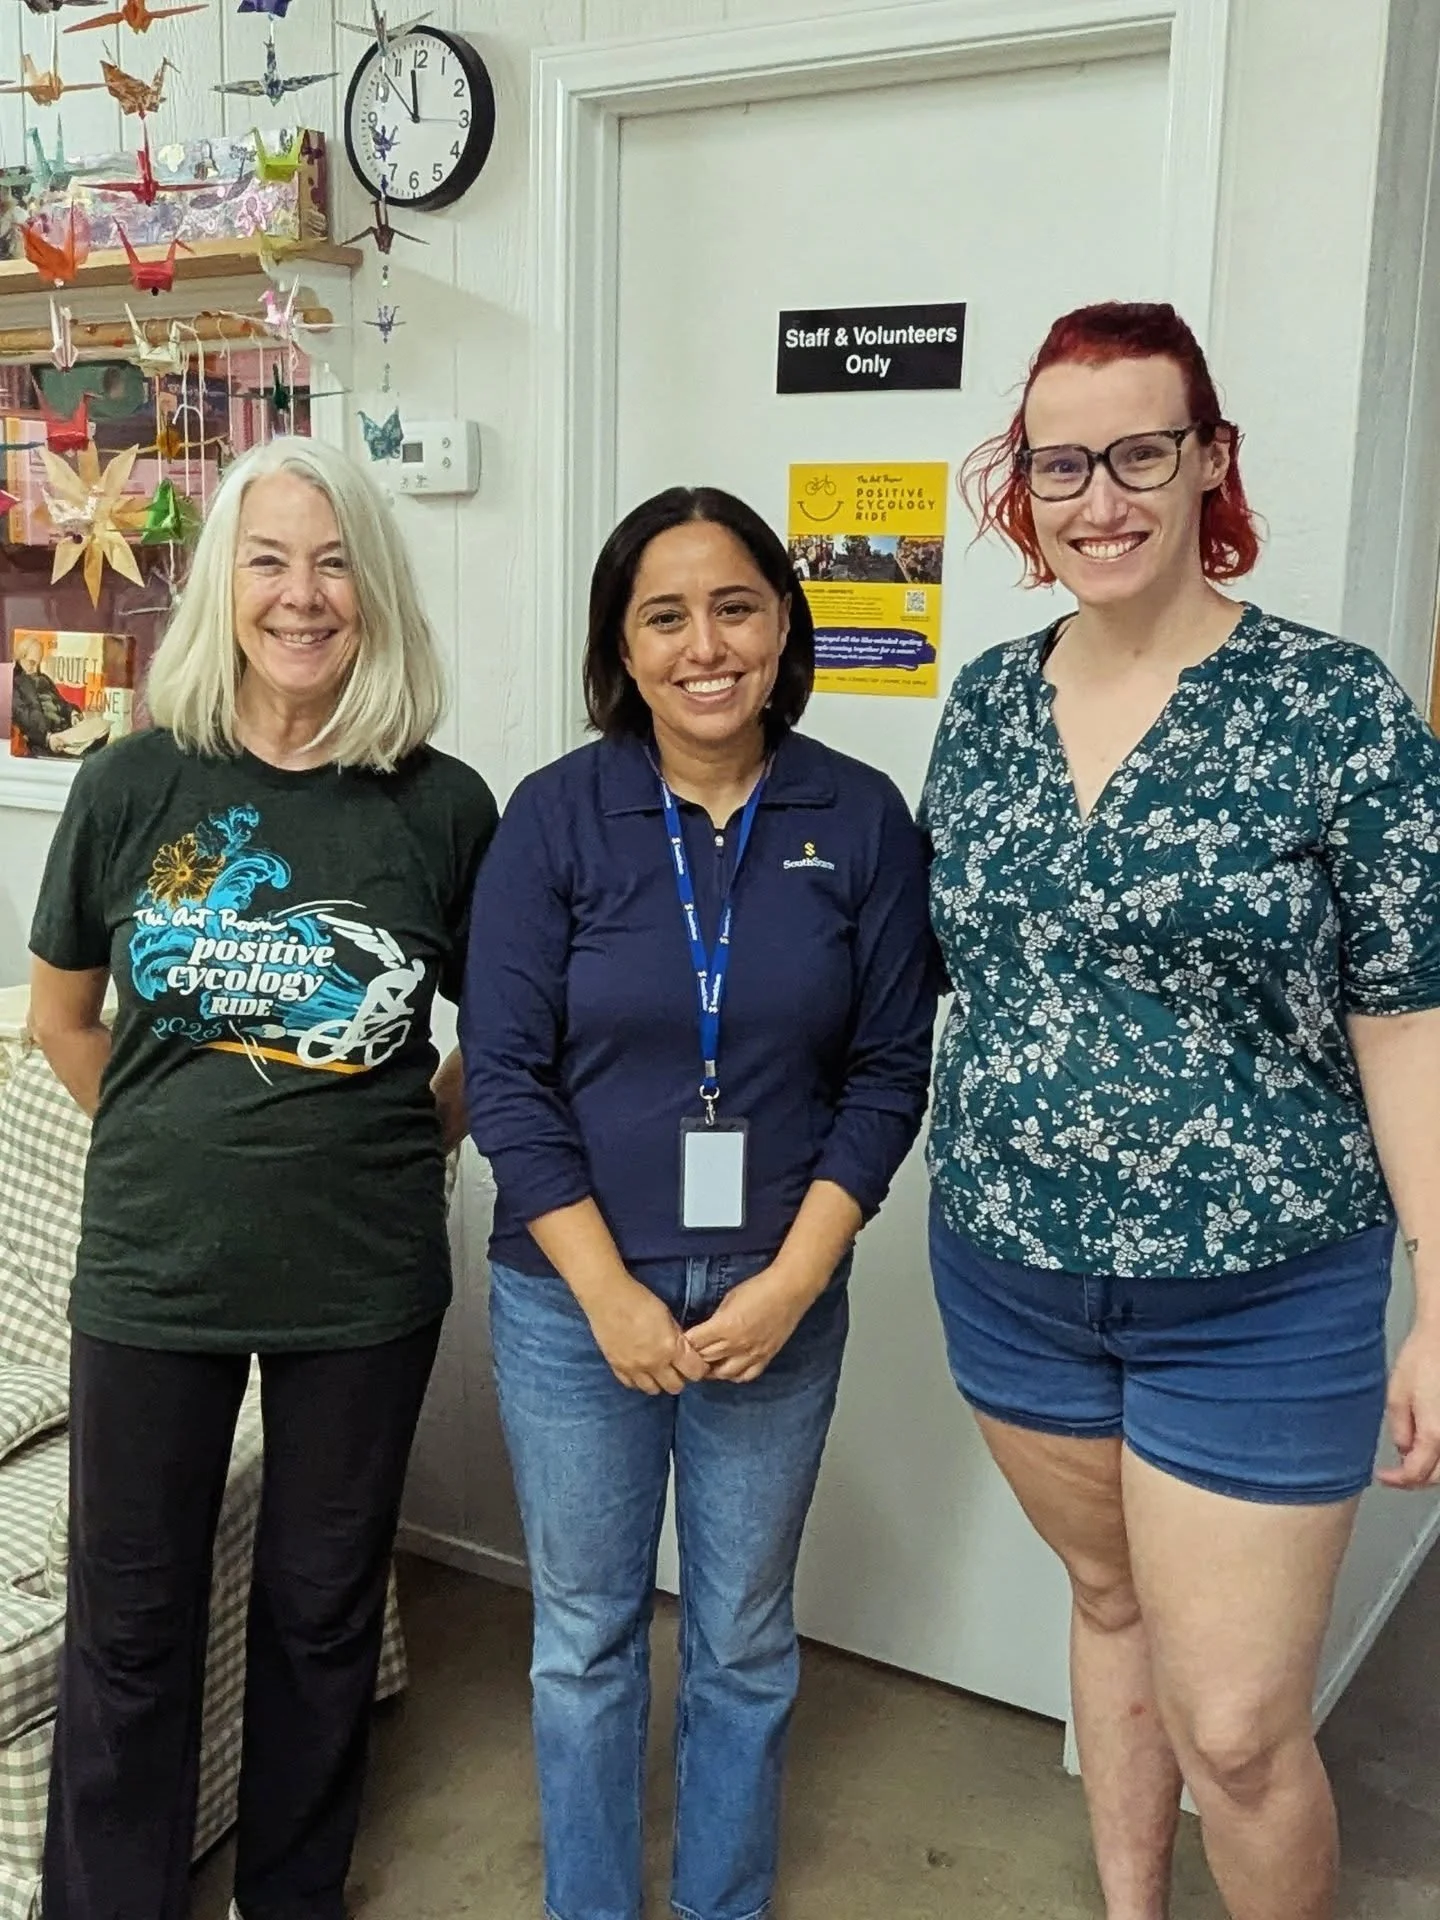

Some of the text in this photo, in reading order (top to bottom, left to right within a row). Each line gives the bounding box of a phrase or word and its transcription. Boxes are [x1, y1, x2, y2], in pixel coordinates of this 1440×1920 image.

[394, 58, 402, 77] 11
[413, 49, 429, 69] 12
[453, 79, 465, 98] 2
[367, 111, 379, 129] 9
[458, 109, 470, 129] 3
[450, 140, 461, 160] 4
[388, 163, 398, 182] 7
[409, 171, 420, 190] 6
[432, 163, 443, 182] 5
[785, 325, 958, 348] Staff & Volunteers
[845, 353, 891, 378] Only
[856, 474, 868, 484] The
[869, 475, 882, 484] Art
[856, 487, 924, 498] POSITIVE
[855, 499, 936, 511] CYCOLOGY
[855, 511, 888, 522] RIDE
[87, 689, 121, 714] ZONE
[132, 906, 288, 932] The Art Room
[187, 934, 336, 968] positive
[166, 963, 325, 1002] cycology
[209, 995, 274, 1017] RIDE
